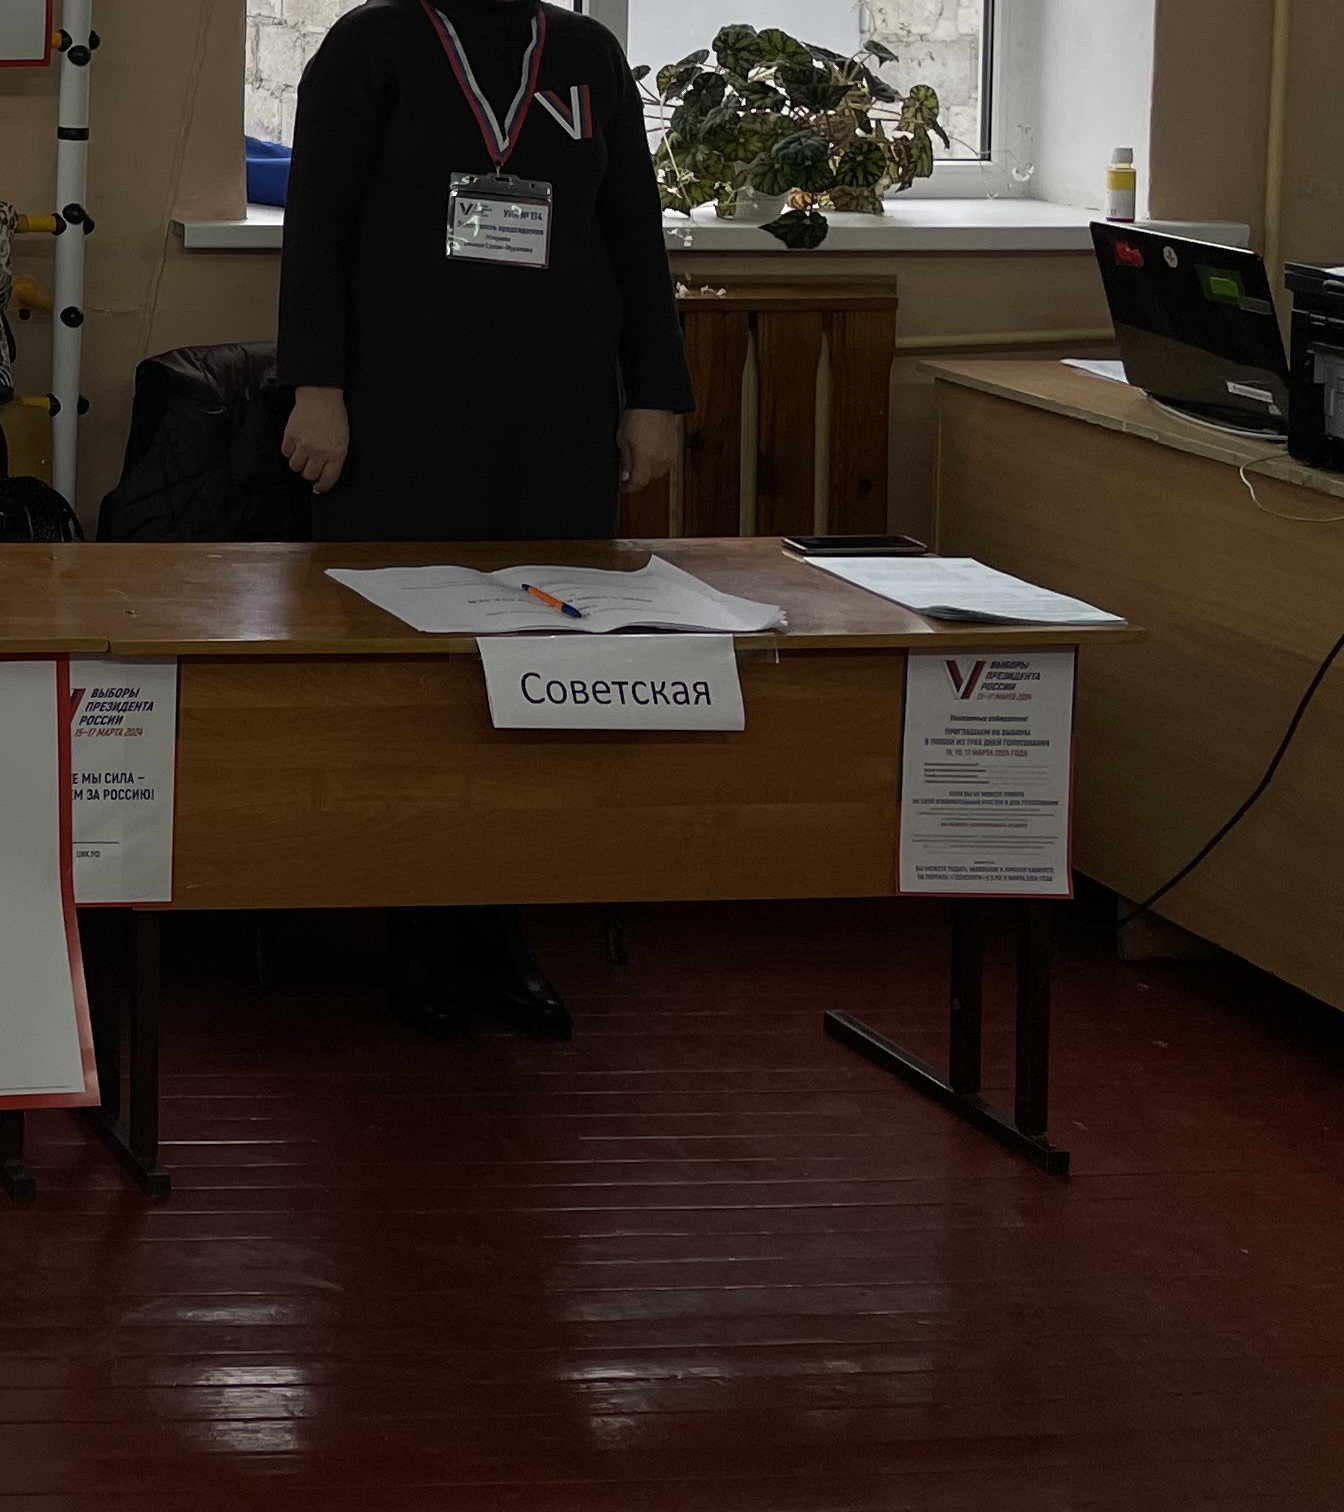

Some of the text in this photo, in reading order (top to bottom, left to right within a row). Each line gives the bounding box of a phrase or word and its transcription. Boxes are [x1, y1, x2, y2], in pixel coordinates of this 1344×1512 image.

[90, 687, 140, 699] ВЫБОРЫ
[521, 671, 713, 708] Советская
[85, 701, 154, 713] ПРЕЗИДЕНТА
[79, 715, 124, 726] РОССИИ
[96, 728, 123, 737] МАРТА
[82, 772, 102, 785] МЫ
[104, 772, 134, 784] СИЛА
[86, 789, 100, 801] ЗА
